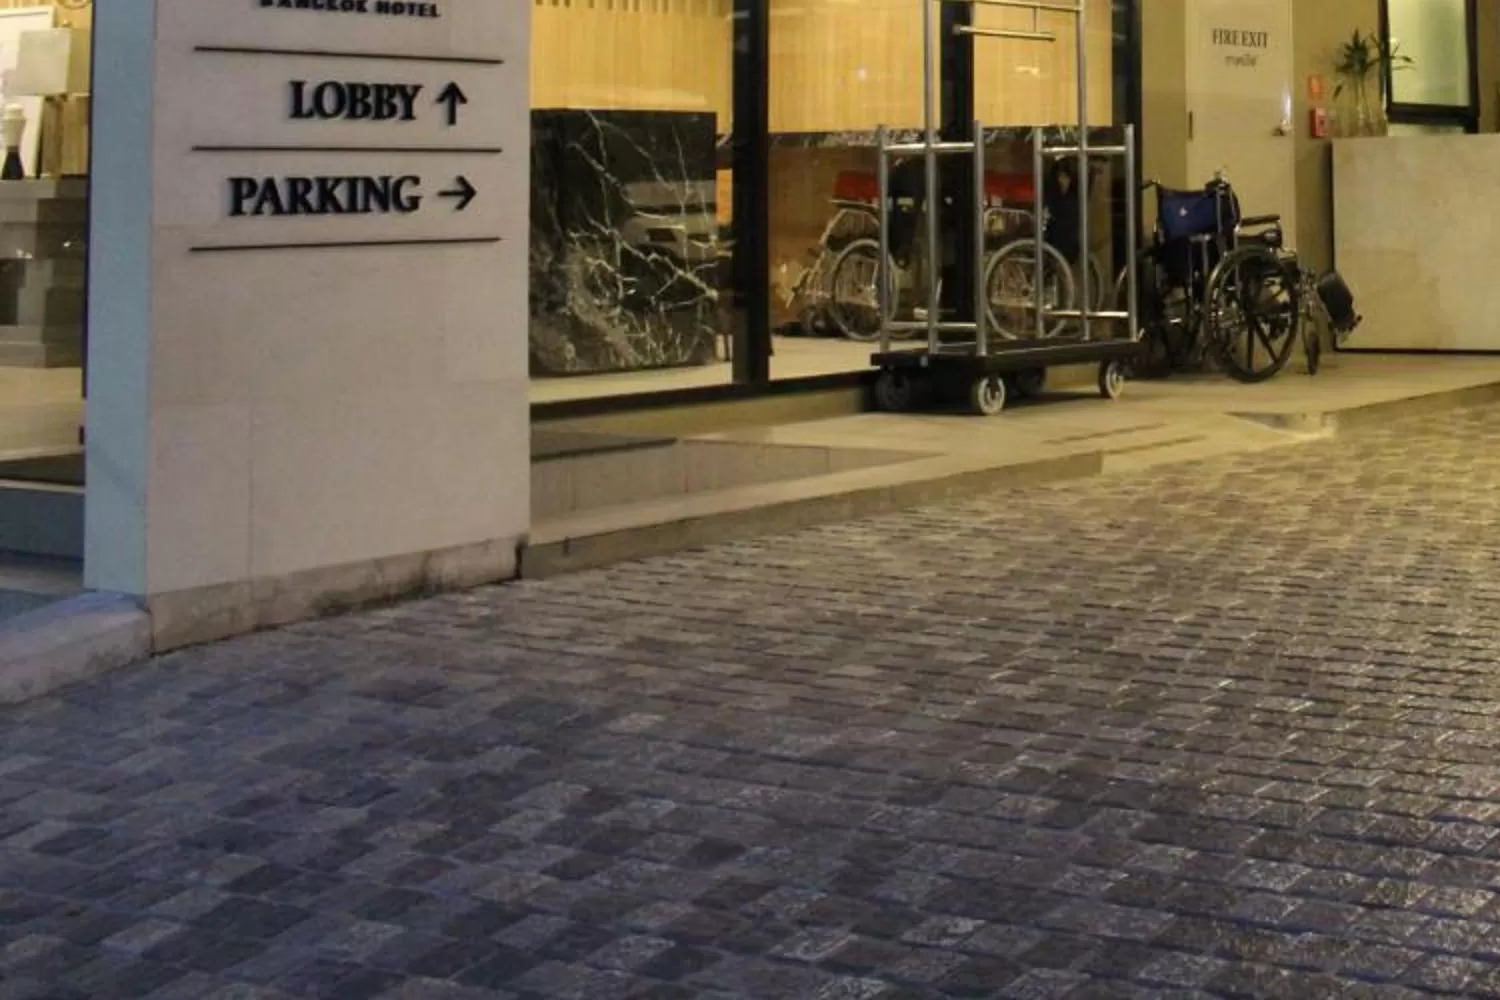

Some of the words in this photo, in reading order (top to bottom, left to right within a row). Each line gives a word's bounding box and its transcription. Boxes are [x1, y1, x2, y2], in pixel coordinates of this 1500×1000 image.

[1212, 28, 1240, 46] FIRE
[1242, 30, 1268, 48] EXIT
[288, 79, 424, 121] LOBBY
[227, 175, 422, 217] PARKING
